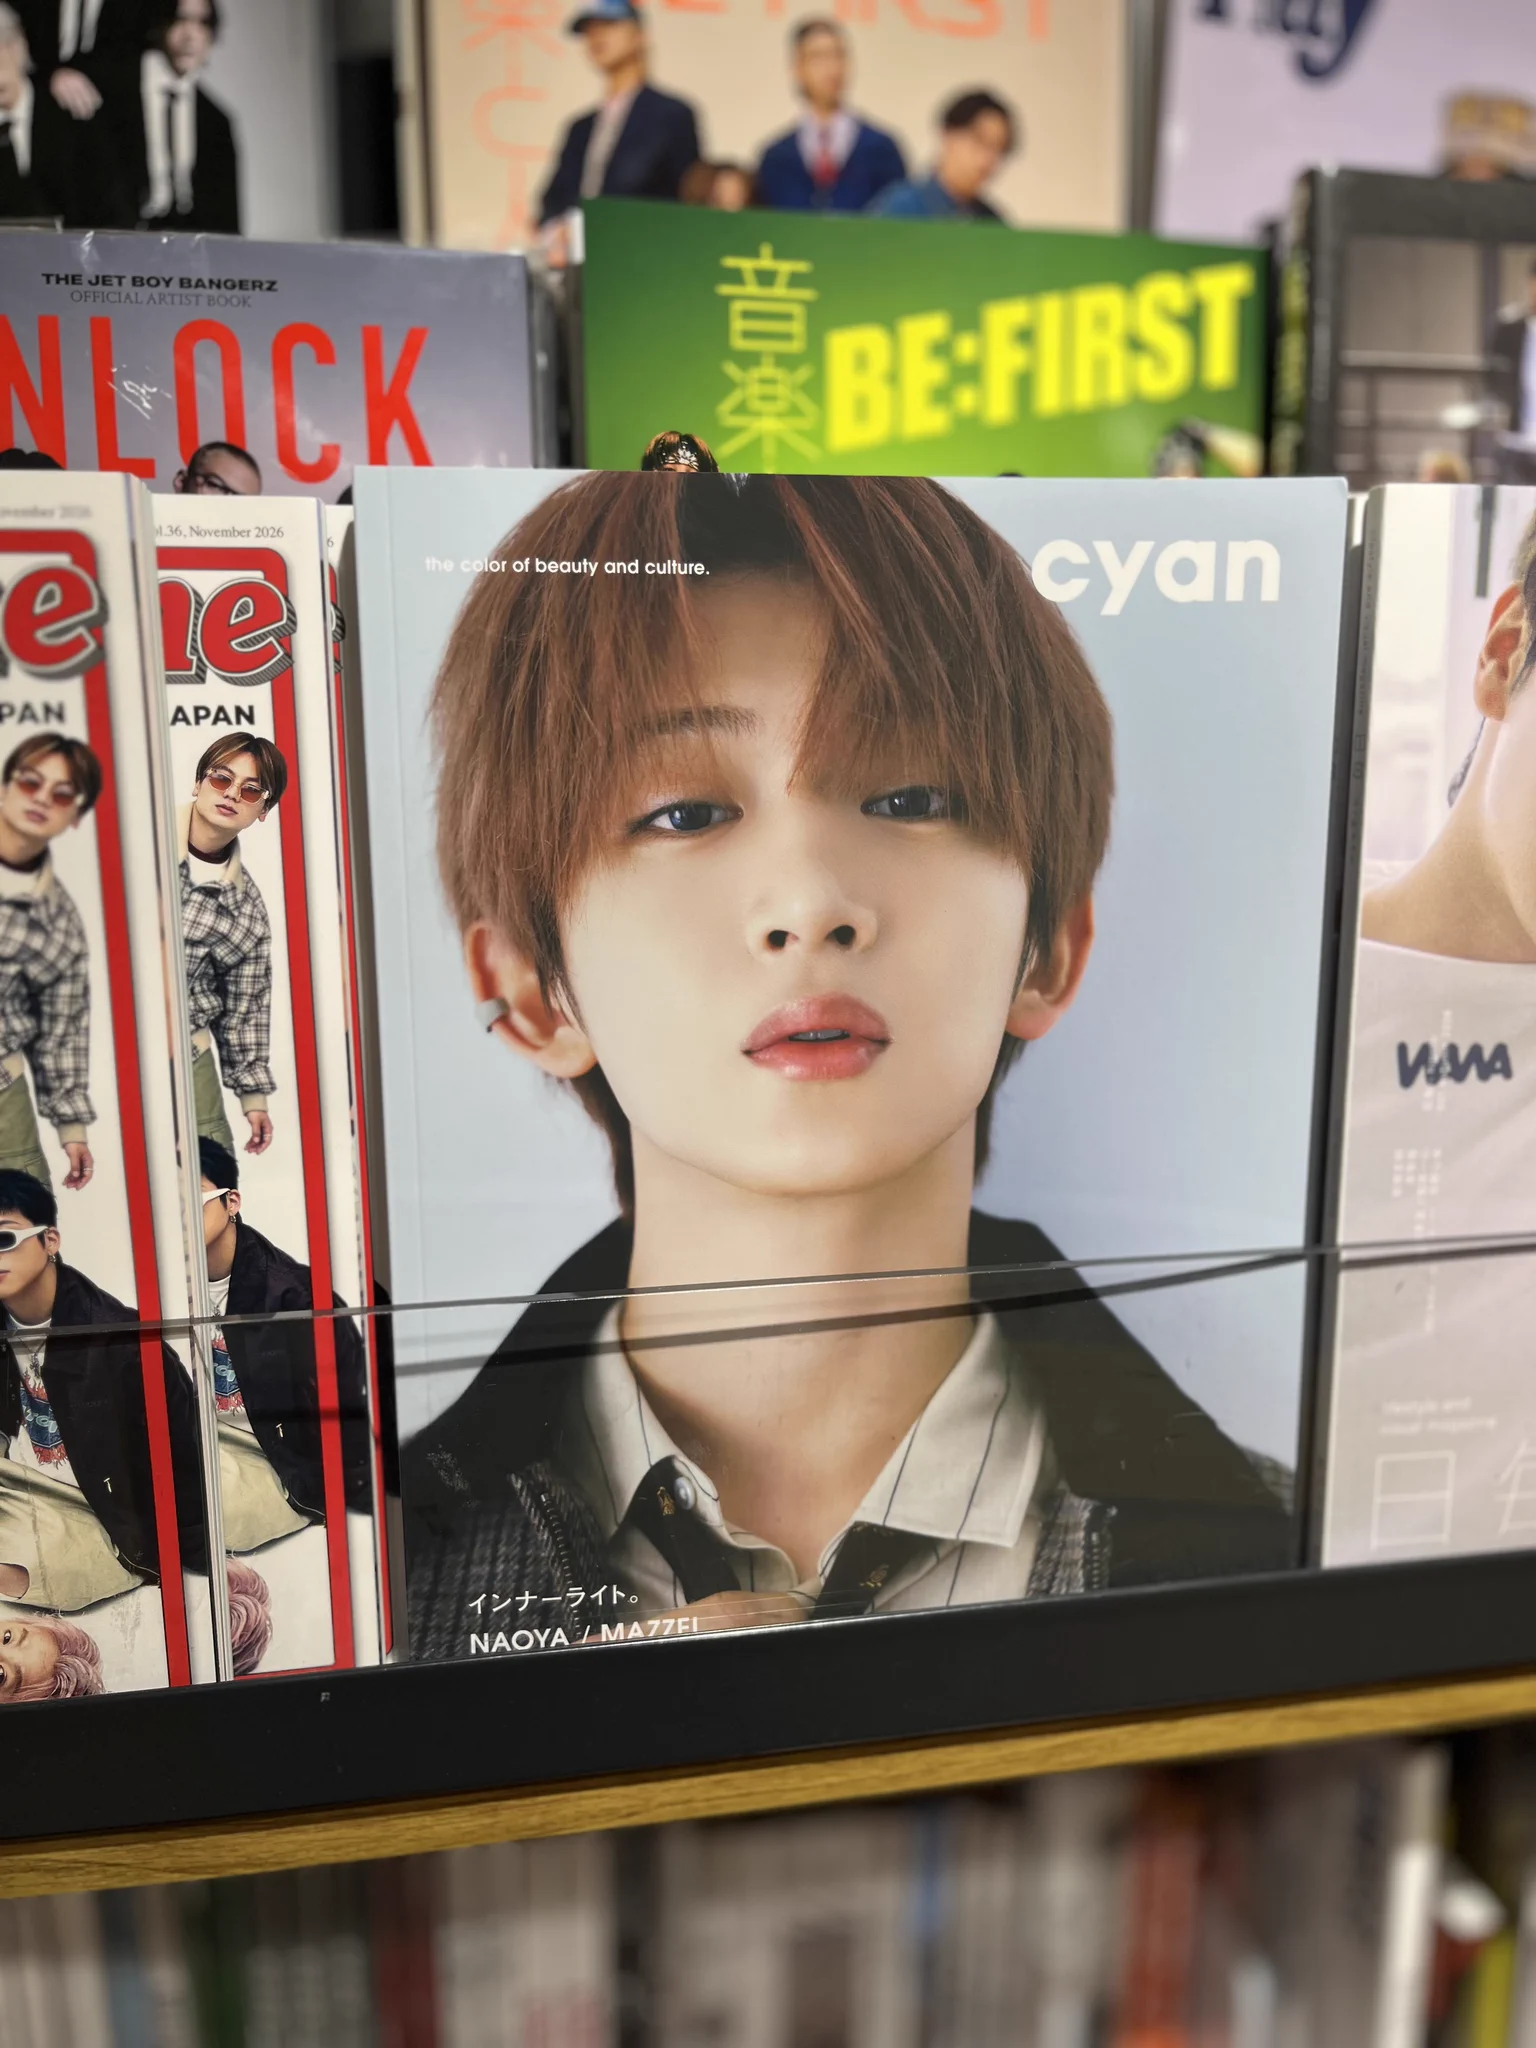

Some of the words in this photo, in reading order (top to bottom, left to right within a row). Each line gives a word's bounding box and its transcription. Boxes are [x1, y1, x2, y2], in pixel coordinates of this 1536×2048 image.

[41, 273, 83, 286] THE
[88, 274, 126, 287] JET
[131, 275, 173, 288] BOY
[179, 277, 279, 292] BANGERZ
[70, 290, 144, 304] OFFICIAL
[147, 291, 204, 306] ARTIST
[207, 293, 252, 308] BOOK
[716, 243, 824, 472] 音楽
[825, 260, 1255, 455] BE:FIRST
[189, 525, 252, 538] November
[254, 526, 285, 538] 2026
[425, 557, 454, 573] the
[460, 558, 507, 573] color
[512, 558, 532, 573] of
[535, 558, 599, 577] beauty
[604, 559, 640, 575] and
[644, 560, 711, 576] culture.
[1031, 539, 1282, 616] cyan
[468, 1584, 639, 1614] インナーライト。
[469, 1627, 570, 1655] NAOYA
